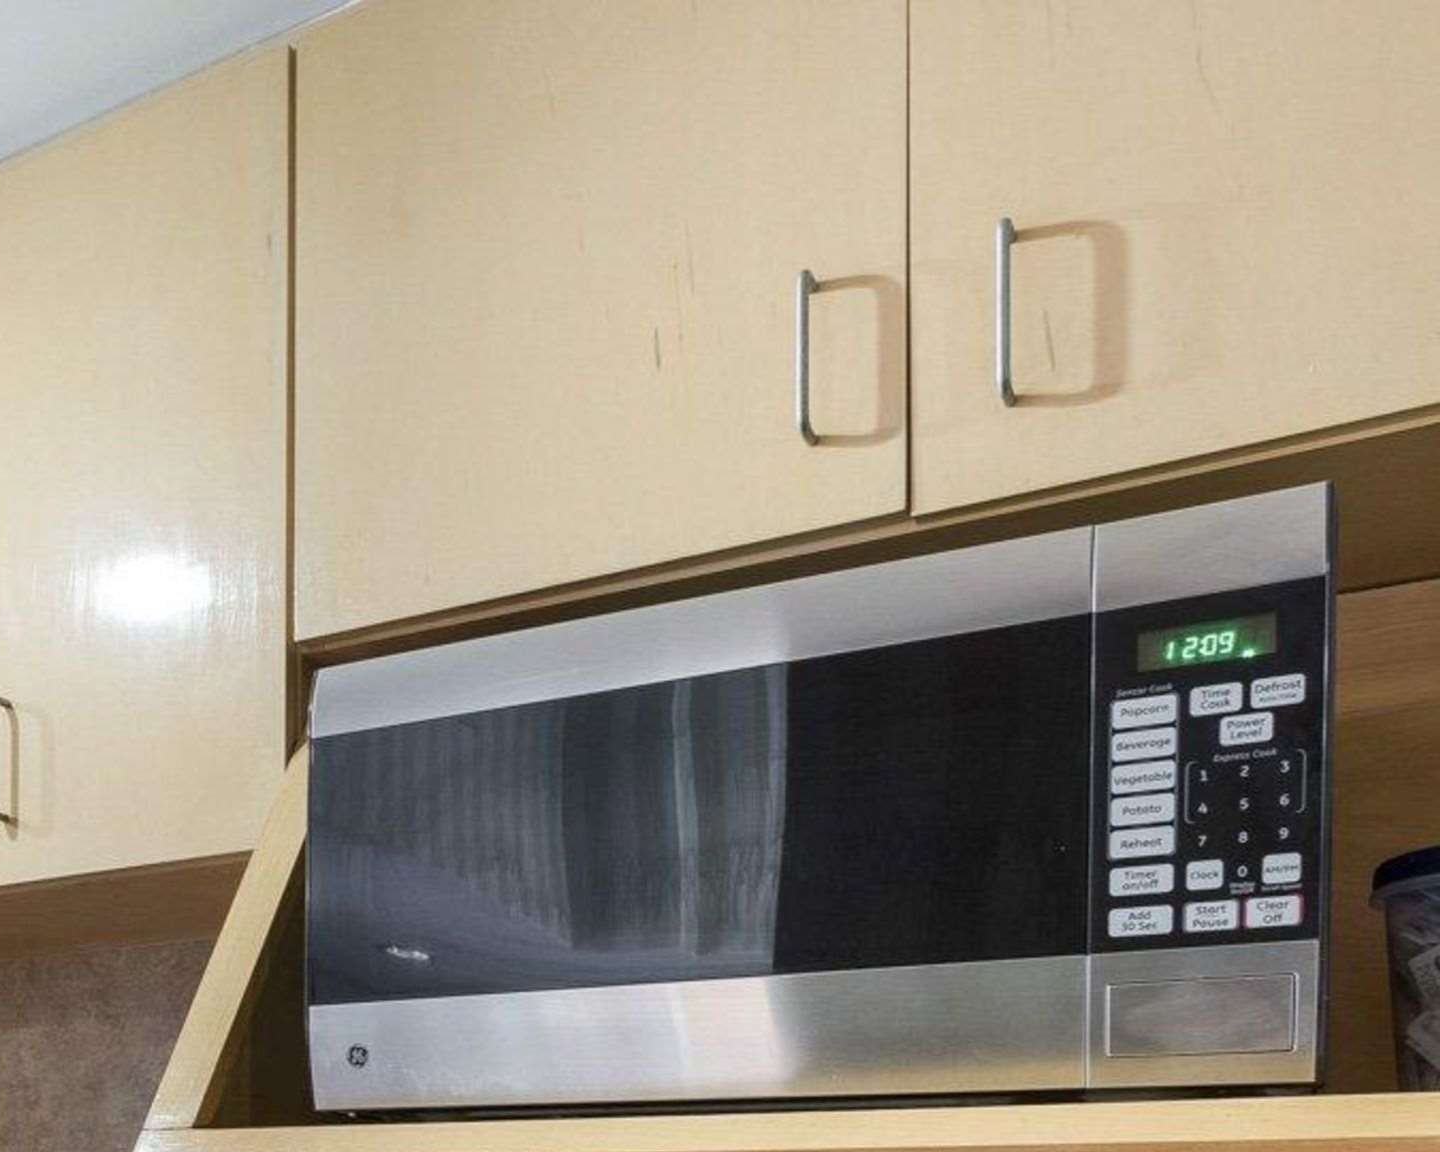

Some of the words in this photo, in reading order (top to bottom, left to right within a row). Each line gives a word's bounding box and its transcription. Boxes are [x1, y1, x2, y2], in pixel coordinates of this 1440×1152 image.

[1254, 679, 1301, 694] Defrost
[1201, 687, 1230, 699] Time
[1120, 704, 1170, 719] Popcorn
[1200, 700, 1230, 711] Cook
[1226, 717, 1266, 730] Power
[1229, 728, 1263, 740] Level
[1115, 737, 1171, 753] Beverage
[1199, 770, 1208, 782] 1
[1240, 765, 1249, 777] 2
[1280, 760, 1290, 773] 3
[1114, 770, 1172, 786] Vegetable
[1198, 802, 1208, 814] 4
[1239, 798, 1249, 810] 5
[1279, 793, 1290, 806] 6
[1122, 804, 1162, 816] Potato
[1120, 837, 1162, 849] Reheat
[1198, 835, 1208, 847] 7
[1238, 831, 1248, 843] 8
[1278, 827, 1289, 840] 9
[1124, 870, 1158, 880] Timer
[1190, 871, 1219, 880] Clock
[1237, 865, 1248, 878] 0
[1122, 878, 1159, 891] on/off
[1196, 904, 1228, 916] Start
[1257, 900, 1289, 912] Clear
[1128, 911, 1152, 921] Add
[1262, 914, 1283, 925] Off
[1138, 920, 1157, 931] Sec
[1192, 917, 1229, 929] Pause
